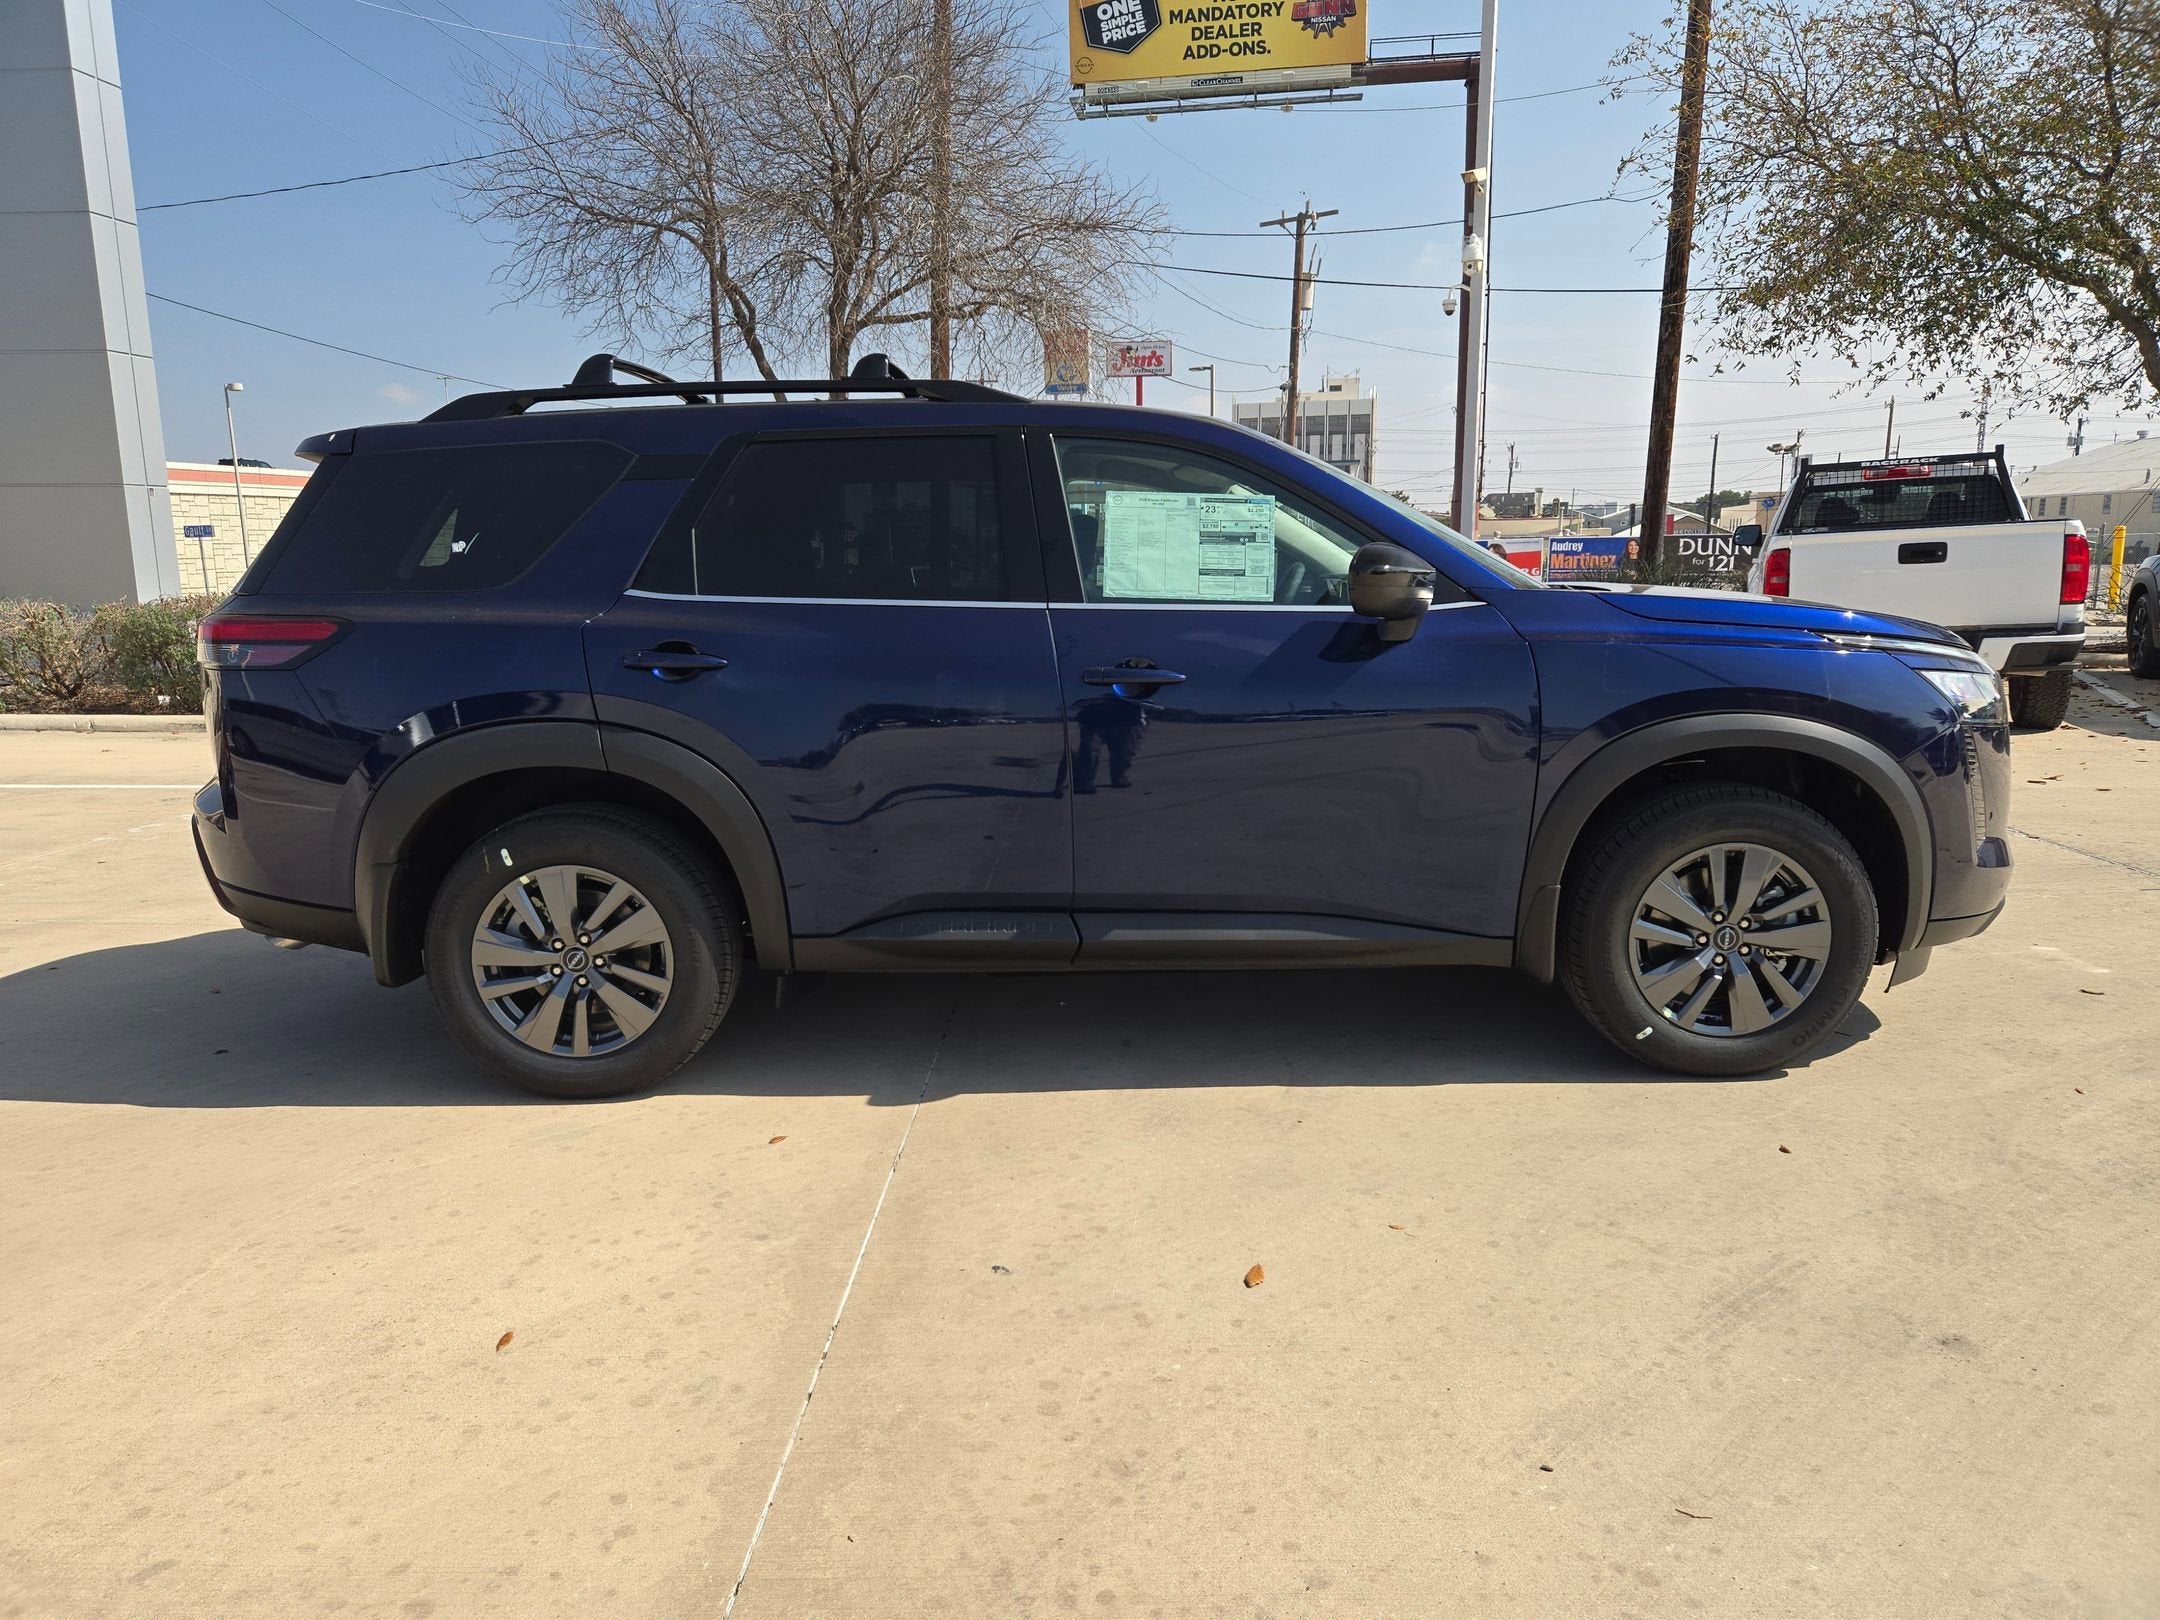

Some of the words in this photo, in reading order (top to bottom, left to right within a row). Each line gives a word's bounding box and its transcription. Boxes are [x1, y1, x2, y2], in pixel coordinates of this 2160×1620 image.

[1097, 0, 1142, 21] ONE
[1169, 1, 1285, 24] MANDATORY
[1293, 0, 1356, 19] GUNN
[1100, 10, 1144, 31] SIMPLE
[1101, 20, 1147, 44] PRICE
[1191, 22, 1262, 41] DEALER
[1183, 40, 1271, 60] ADD-ONS.
[1860, 457, 1939, 467] BACKRACK
[1205, 505, 1216, 514] 23
[1551, 541, 1584, 552] Audrey
[1550, 552, 1617, 570] Martinez
[1708, 555, 1735, 571] 121
